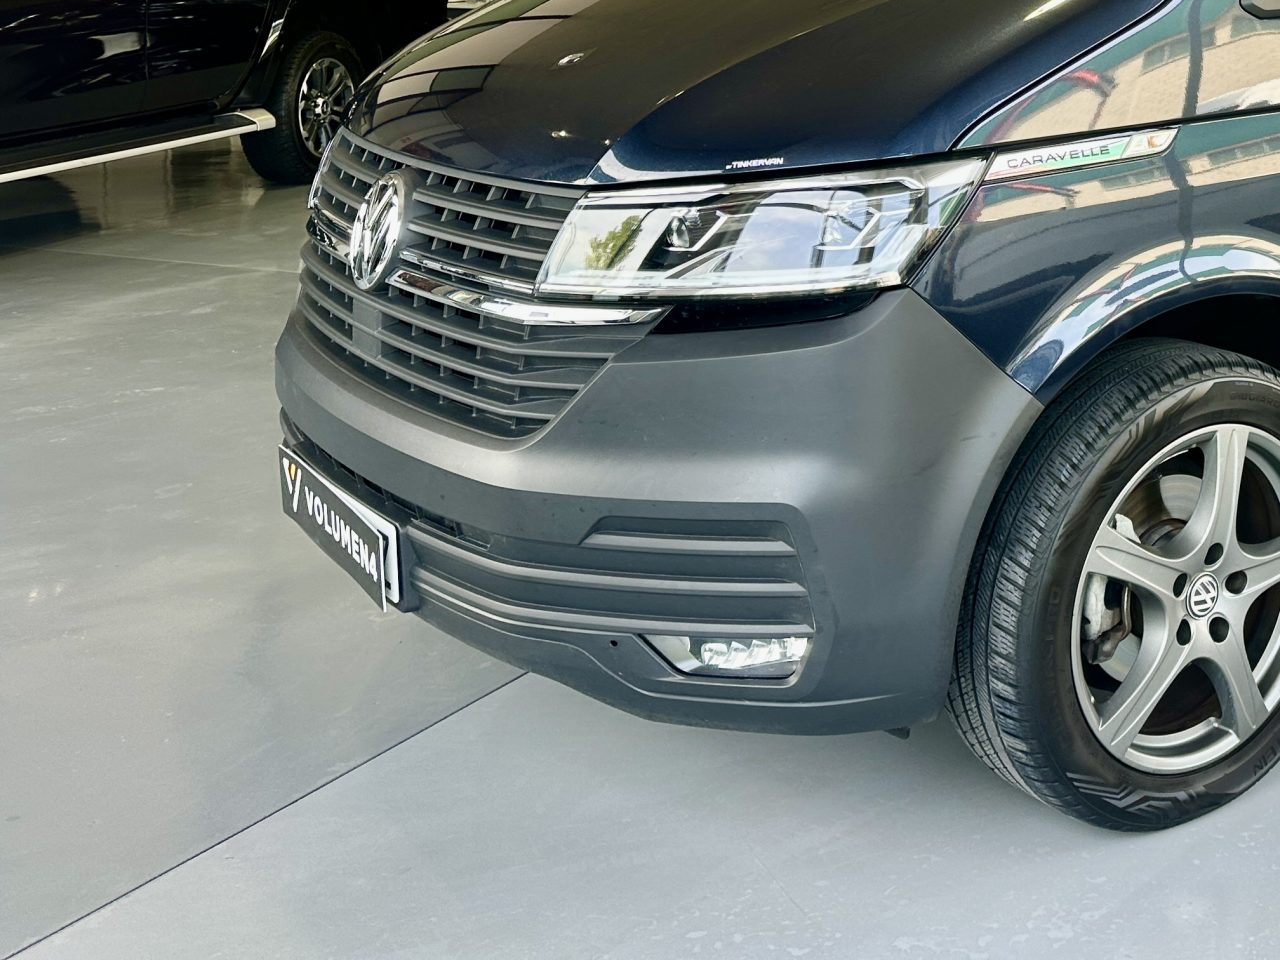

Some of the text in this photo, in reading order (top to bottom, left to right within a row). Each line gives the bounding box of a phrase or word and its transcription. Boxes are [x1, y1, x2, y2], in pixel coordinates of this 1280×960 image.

[731, 158, 784, 169] TINKERVAN
[1006, 145, 1111, 169] CARAVELLE
[304, 486, 378, 582] VOLUMEN4
